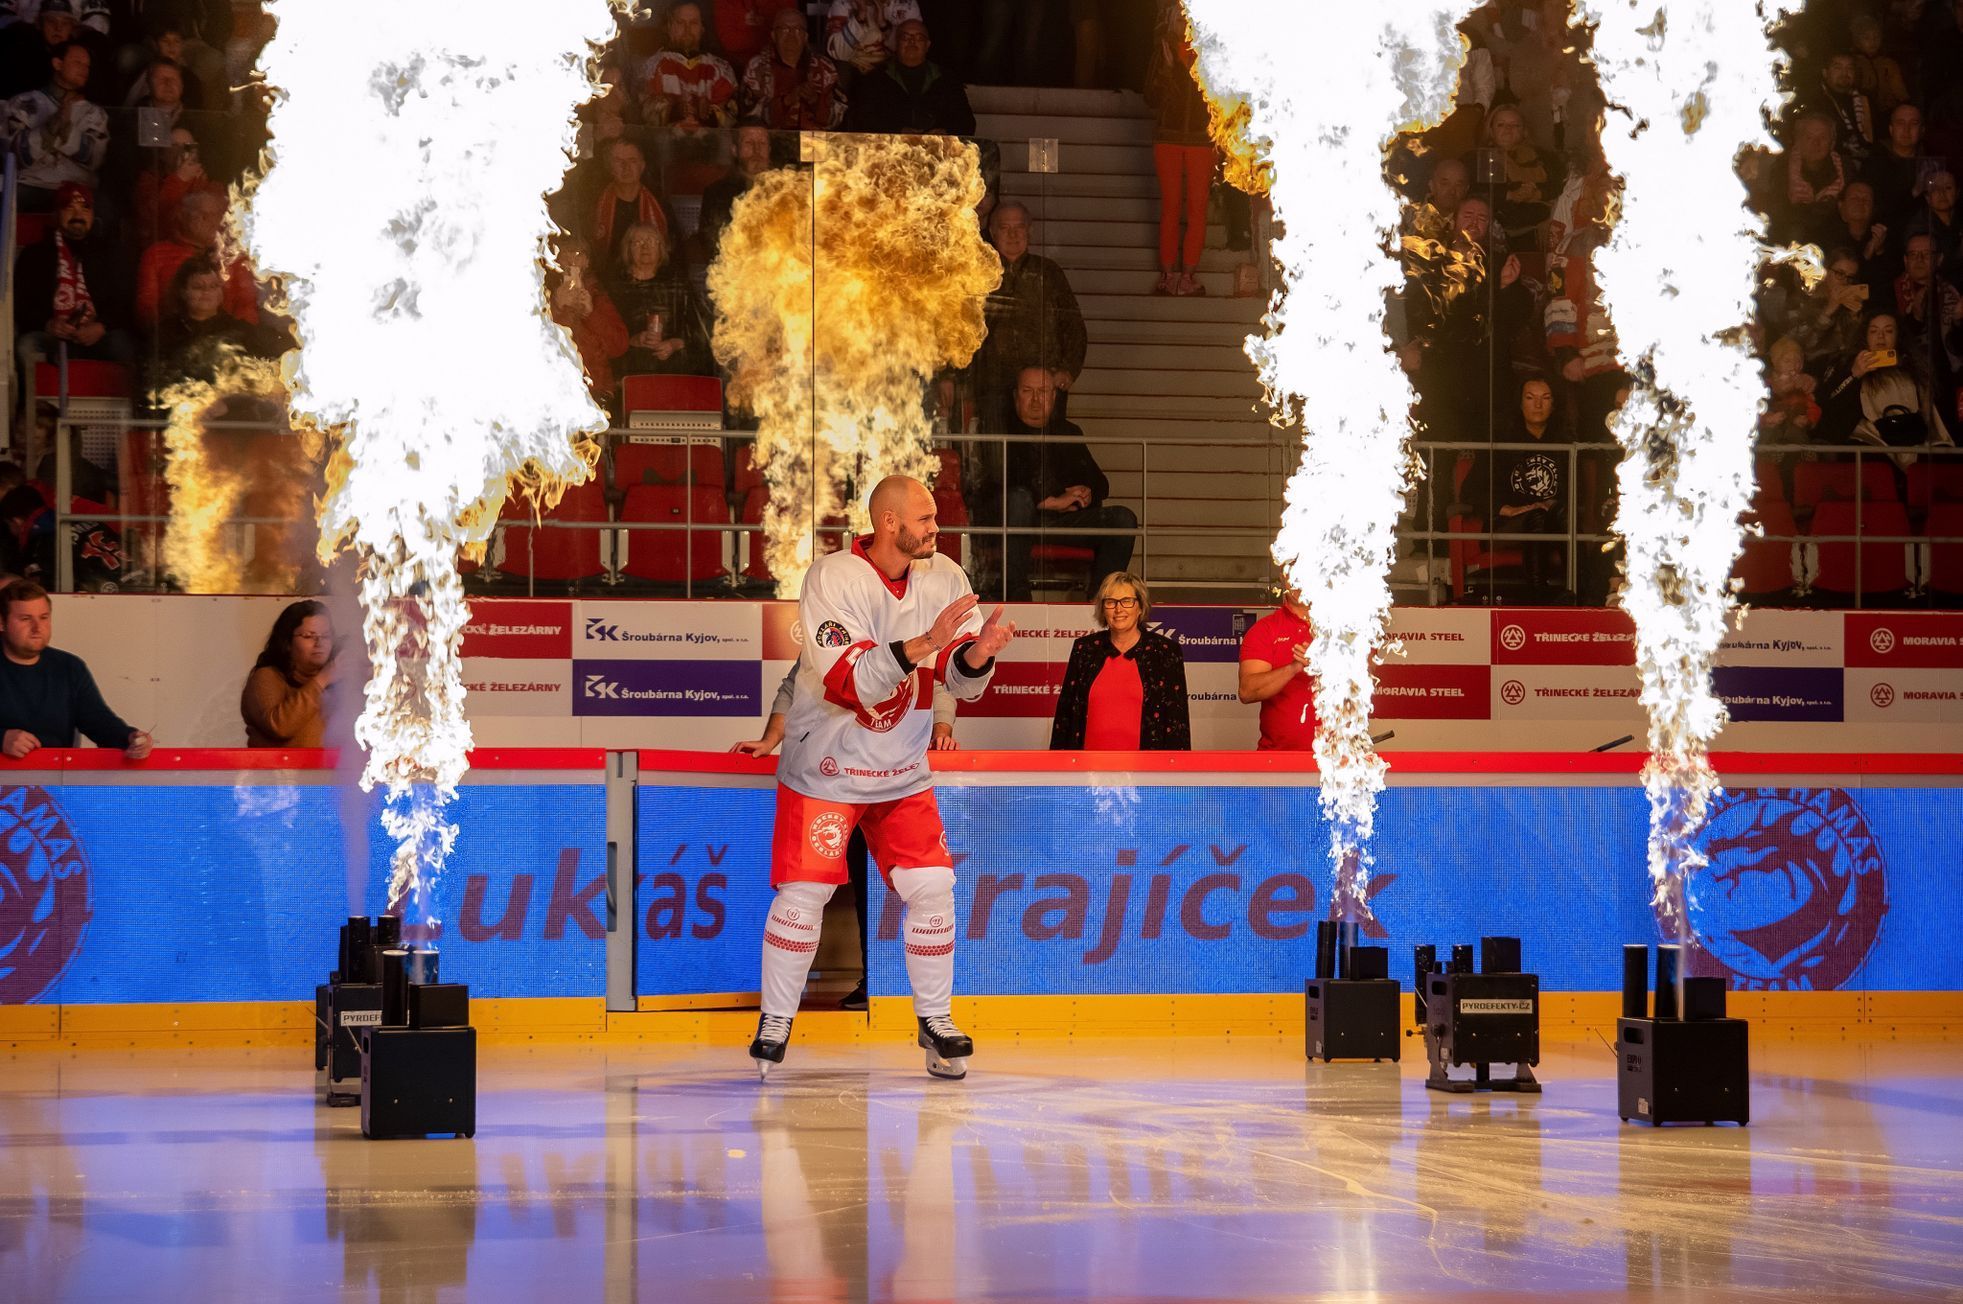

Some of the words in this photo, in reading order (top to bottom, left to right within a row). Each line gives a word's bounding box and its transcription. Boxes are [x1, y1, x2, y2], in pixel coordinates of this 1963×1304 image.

[488, 624, 562, 635] ŽELEZÁRNY
[1013, 629, 1050, 638] NECKÉ
[621, 631, 682, 642] Šroubárna
[686, 632, 720, 644] Kyjov,
[1178, 634, 1237, 645] Šroubárna
[1382, 632, 1426, 641] ORAVIA
[1430, 633, 1465, 641] STEEL
[1534, 632, 1590, 642] TŘINECKÉ
[1903, 636, 1956, 646] MORAVIA
[1772, 639, 1805, 651] Kyjov,
[489, 682, 561, 692] ŽELEZÁRNY
[993, 683, 1050, 695] TŘINECKÉ
[621, 688, 682, 699] Šroubárna
[685, 689, 720, 701] Kyjov,
[1187, 692, 1237, 701] roubárna
[1430, 688, 1465, 697] STEEL
[1534, 688, 1590, 697] TŘINECKÉ
[1903, 691, 1956, 700] MORAVIA
[1772, 695, 1805, 706] Kyjov,
[870, 718, 892, 729] TEAM
[843, 767, 889, 777] TŘINECKÉ
